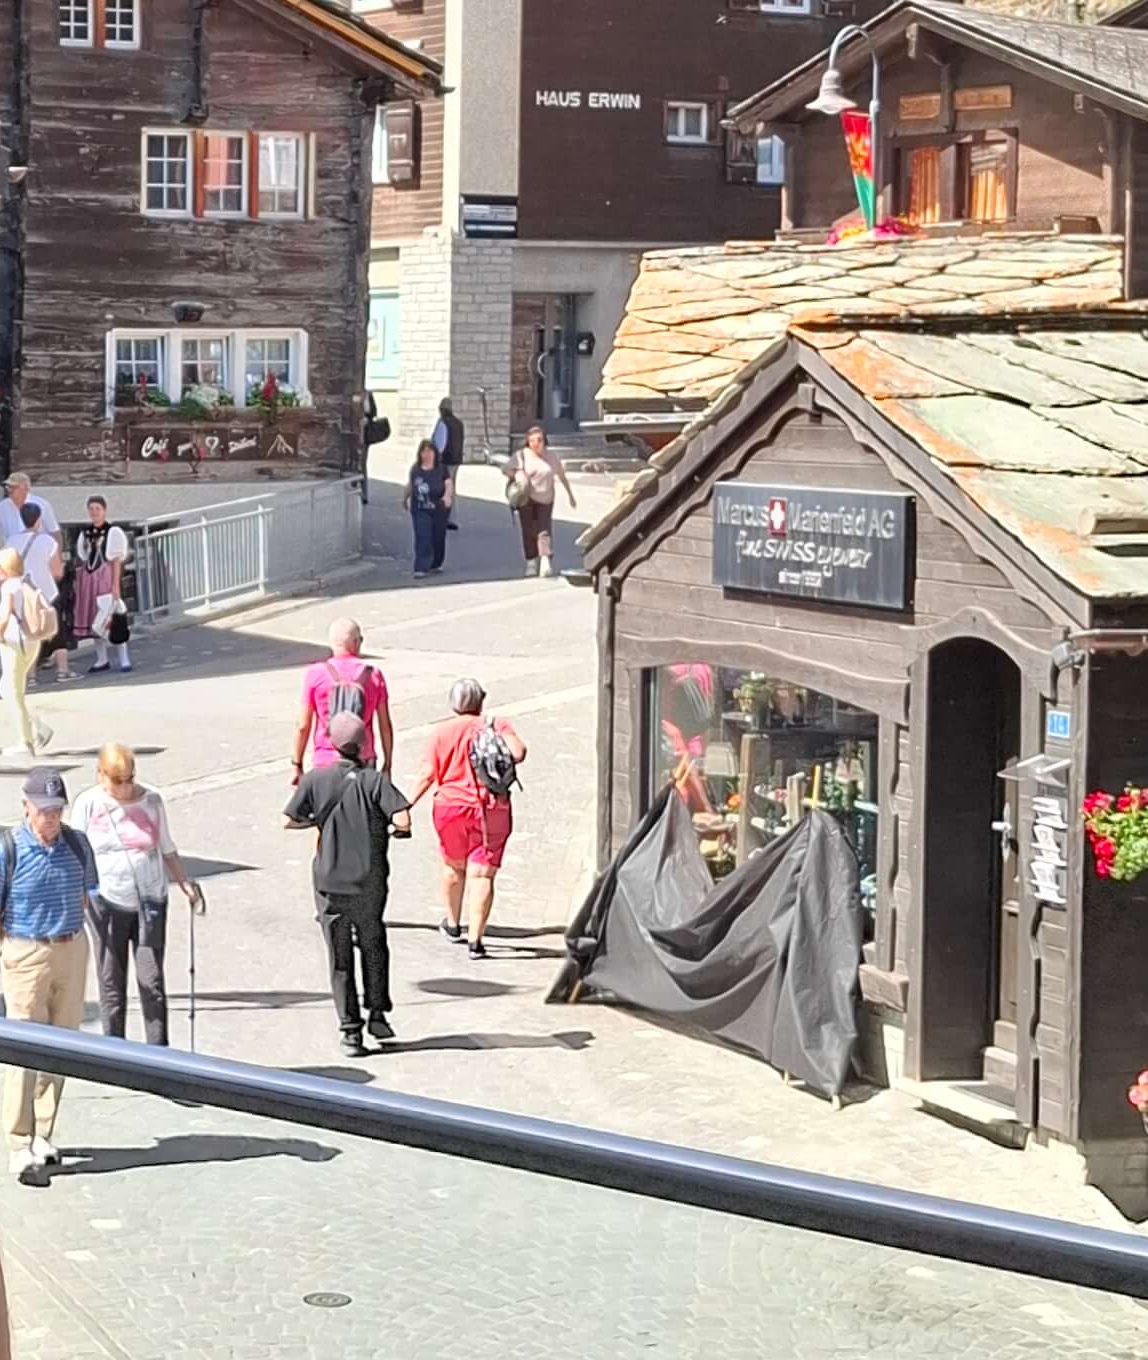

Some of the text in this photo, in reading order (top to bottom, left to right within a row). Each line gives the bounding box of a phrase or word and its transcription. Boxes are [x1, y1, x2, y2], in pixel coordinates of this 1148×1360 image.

[535, 90, 641, 109] HAUS ERWIN
[717, 496, 895, 539] Marcus Marienfeld AG
